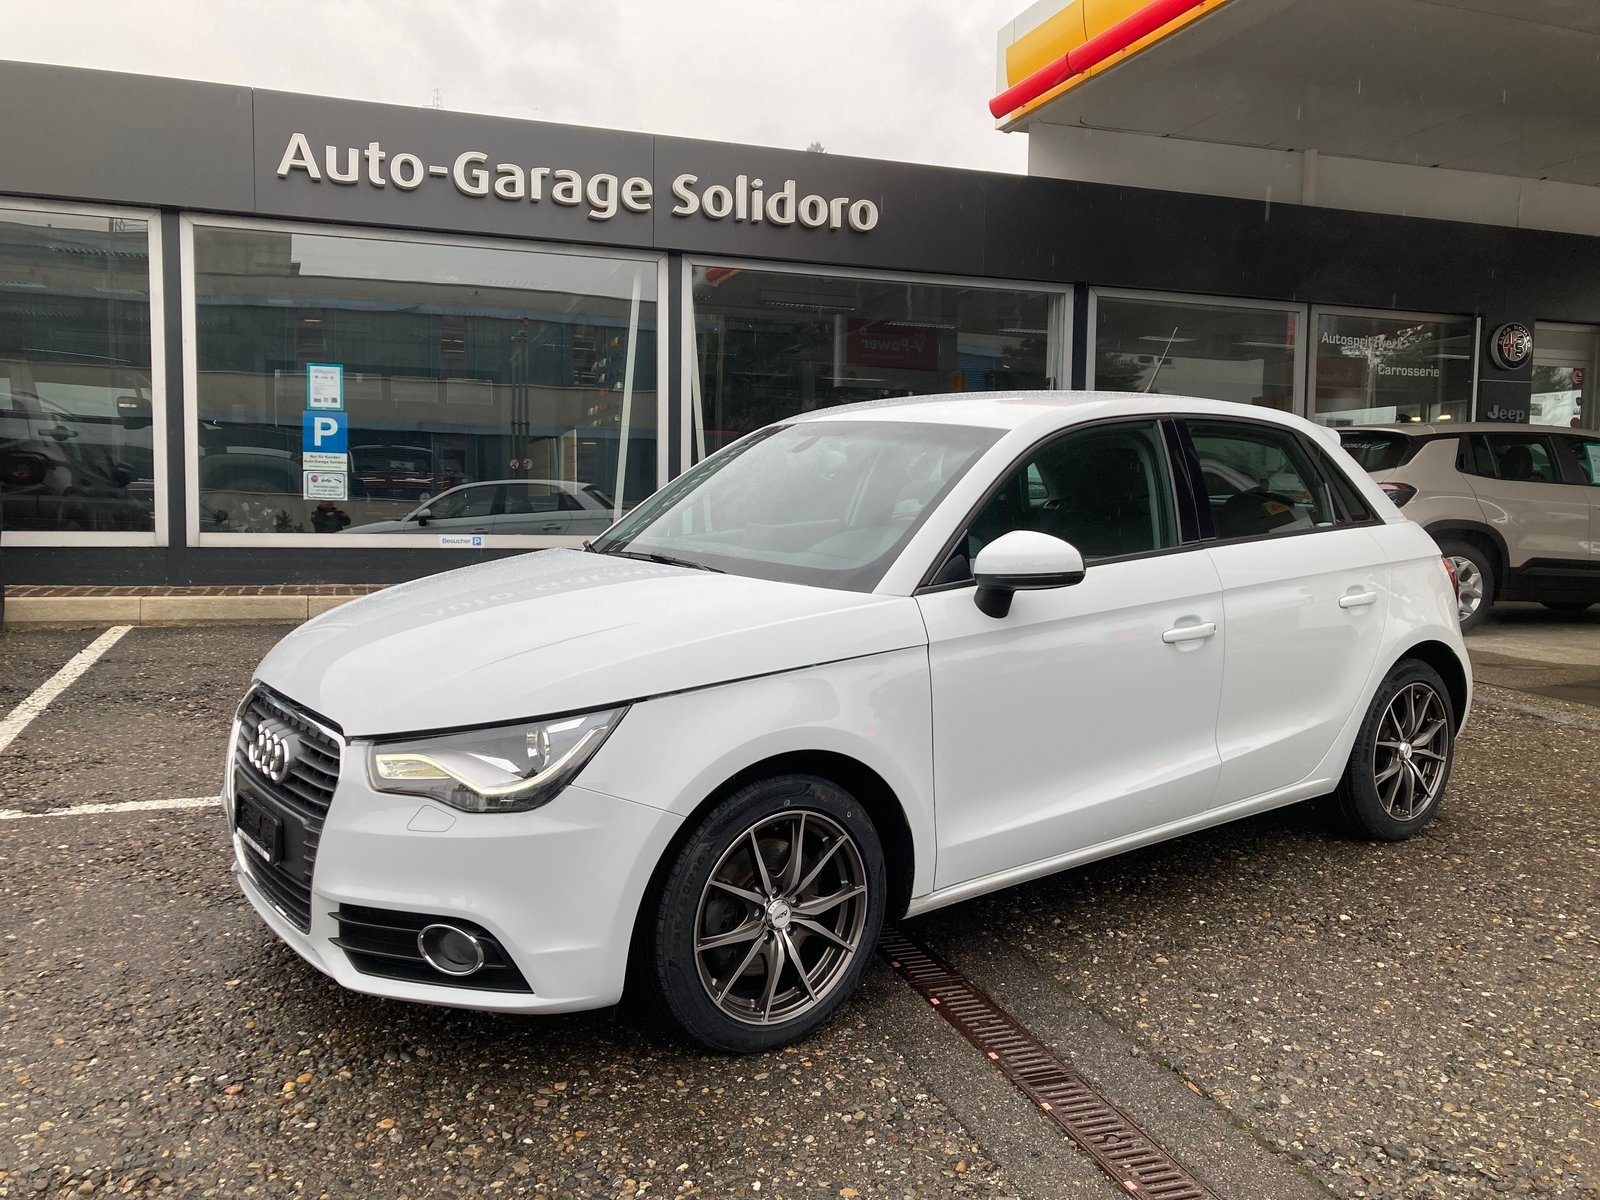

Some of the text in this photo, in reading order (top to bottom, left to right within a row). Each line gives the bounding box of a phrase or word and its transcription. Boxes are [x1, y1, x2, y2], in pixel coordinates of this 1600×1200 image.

[277, 132, 879, 233] Auto-Garage Solidoro
[1499, 325, 1531, 348] ALFA ROMEO
[1378, 364, 1440, 377] Carrosserie
[1487, 404, 1526, 423] Jeep
[314, 417, 338, 446] P
